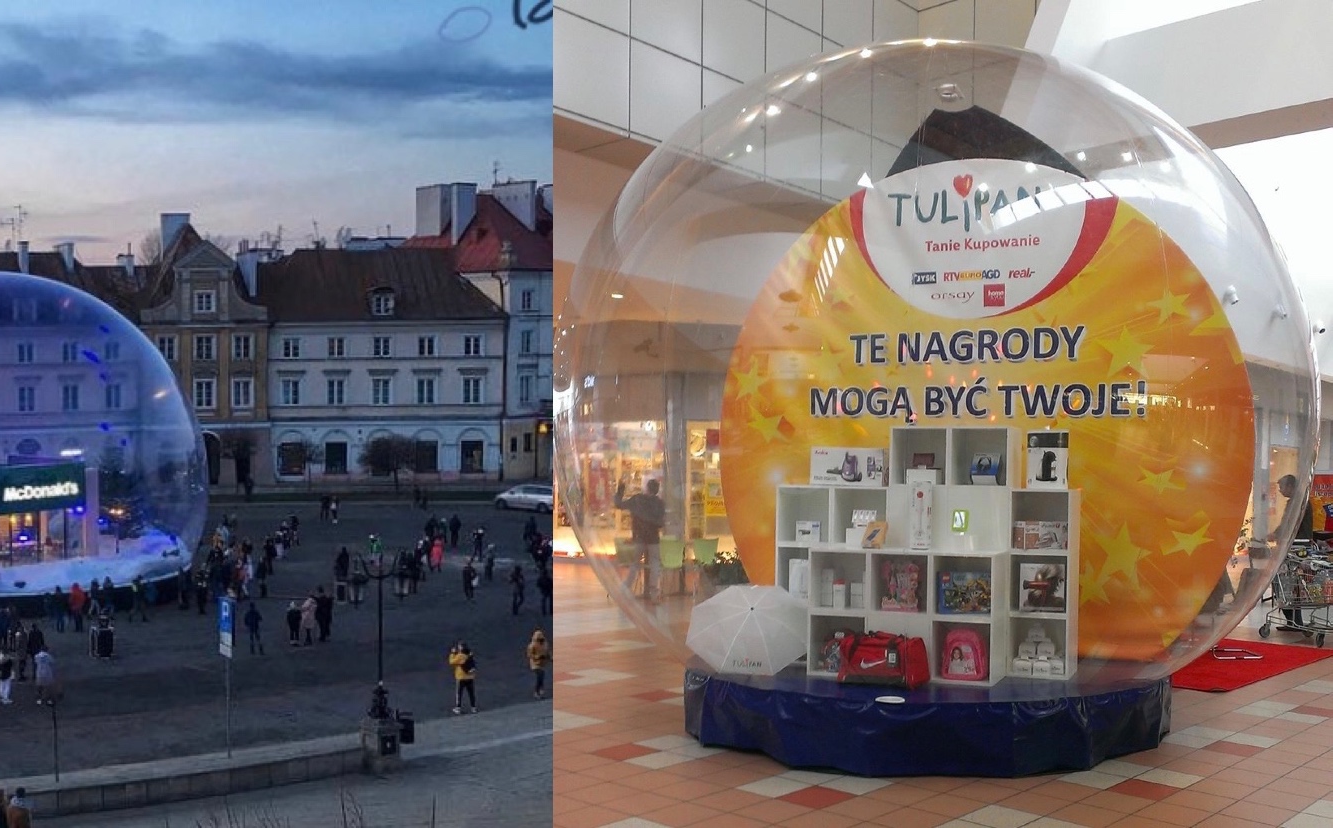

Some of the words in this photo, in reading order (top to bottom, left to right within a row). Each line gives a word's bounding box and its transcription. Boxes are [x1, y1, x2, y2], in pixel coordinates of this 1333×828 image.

[926, 240, 960, 252] Tanie
[964, 235, 1040, 251] Kupowanie
[930, 291, 975, 303] orsay
[850, 334, 886, 364] TE
[897, 325, 1085, 363] NAGRODY
[810, 387, 917, 423] MOGĄ
[924, 378, 987, 416] BYĆ
[997, 380, 1147, 417] TWOJE!
[3, 481, 79, 502] McDonald's
